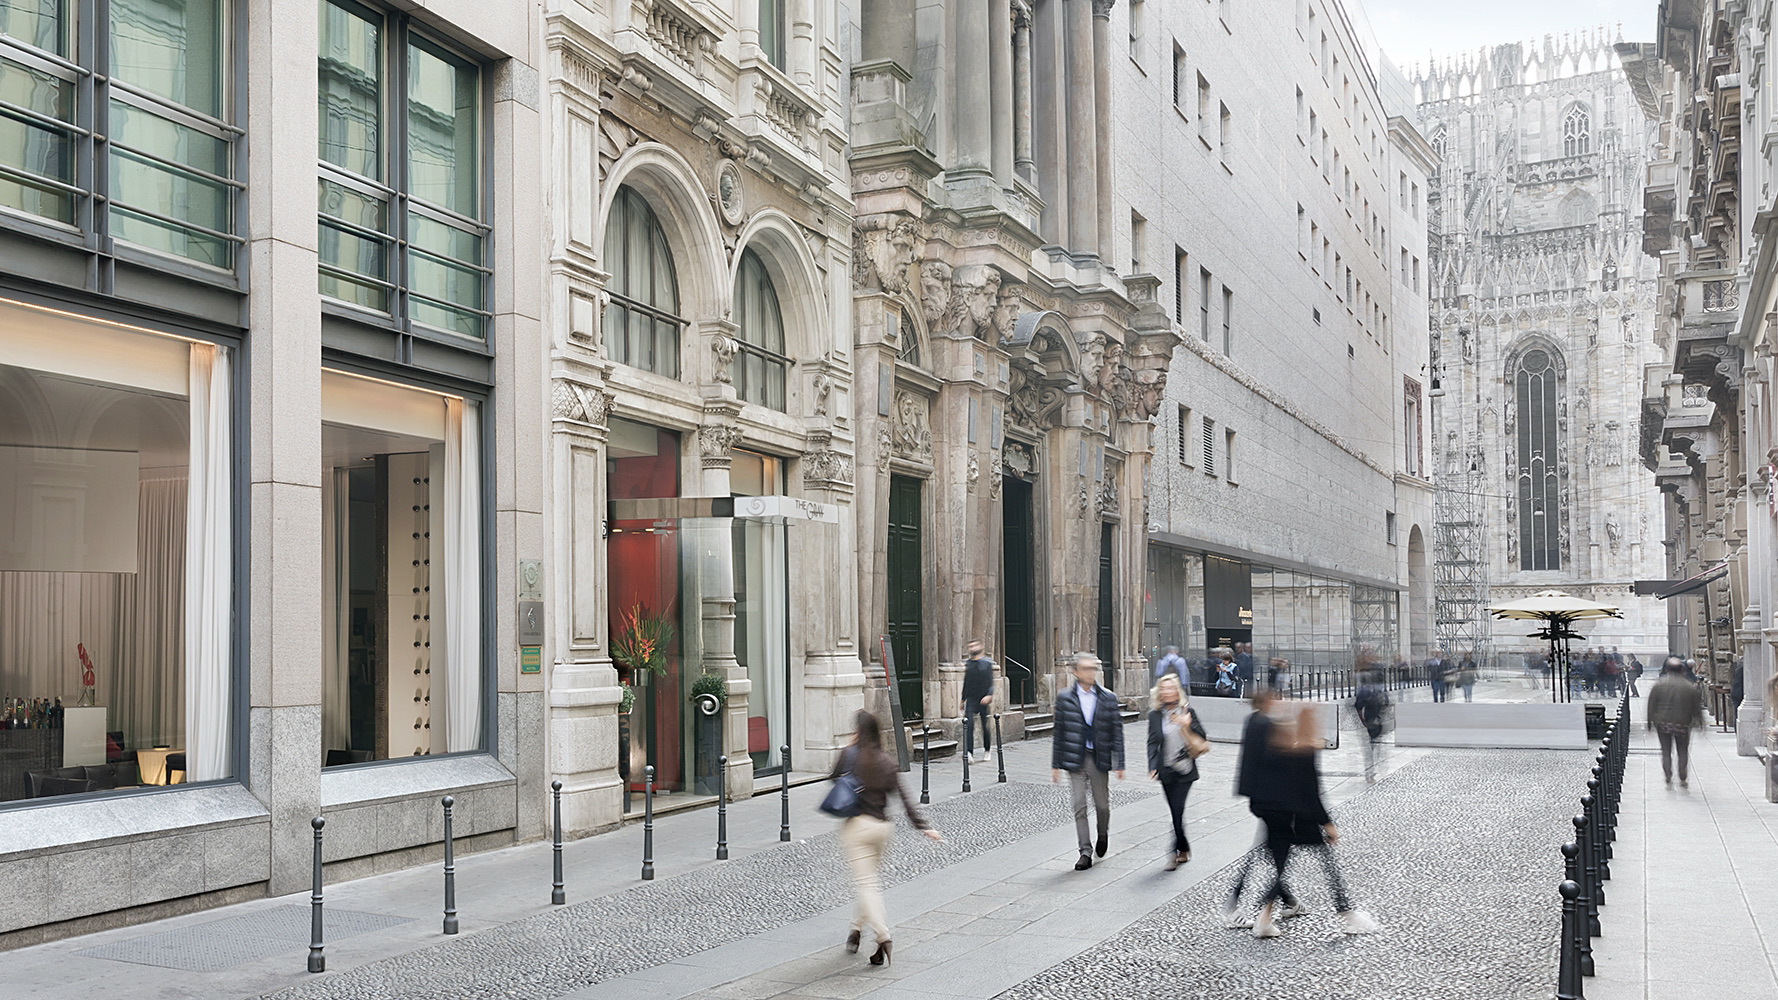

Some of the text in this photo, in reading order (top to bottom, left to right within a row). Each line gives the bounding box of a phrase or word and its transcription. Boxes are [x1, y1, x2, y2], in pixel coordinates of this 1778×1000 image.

[795, 499, 824, 520] THE GRAY
[601, 521, 607, 536] 6
